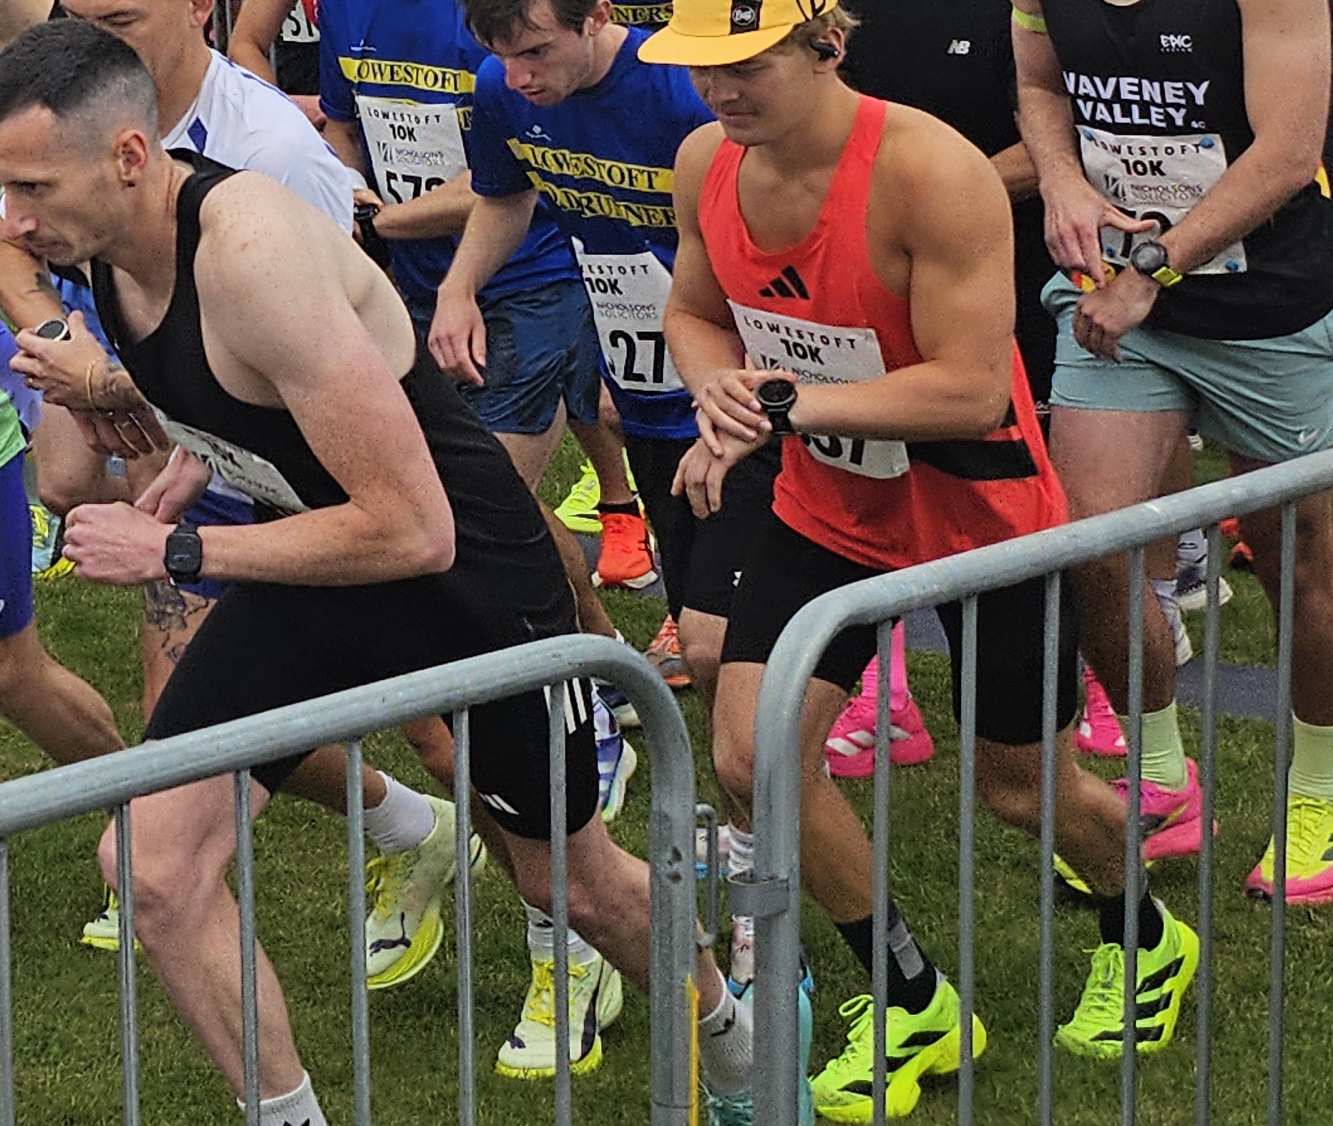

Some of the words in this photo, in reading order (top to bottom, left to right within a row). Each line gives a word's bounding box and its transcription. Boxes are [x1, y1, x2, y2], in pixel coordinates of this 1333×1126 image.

[355, 60, 461, 92] OWESTOFT
[1076, 99, 1187, 128] VALLEY
[389, 123, 418, 143] 10K
[1121, 159, 1167, 177] 10K
[581, 264, 649, 276] ESTOFT
[585, 277, 624, 296] 10K
[743, 315, 857, 351] LOWESTOFT
[608, 329, 665, 384] 27
[779, 337, 826, 366] 10K
